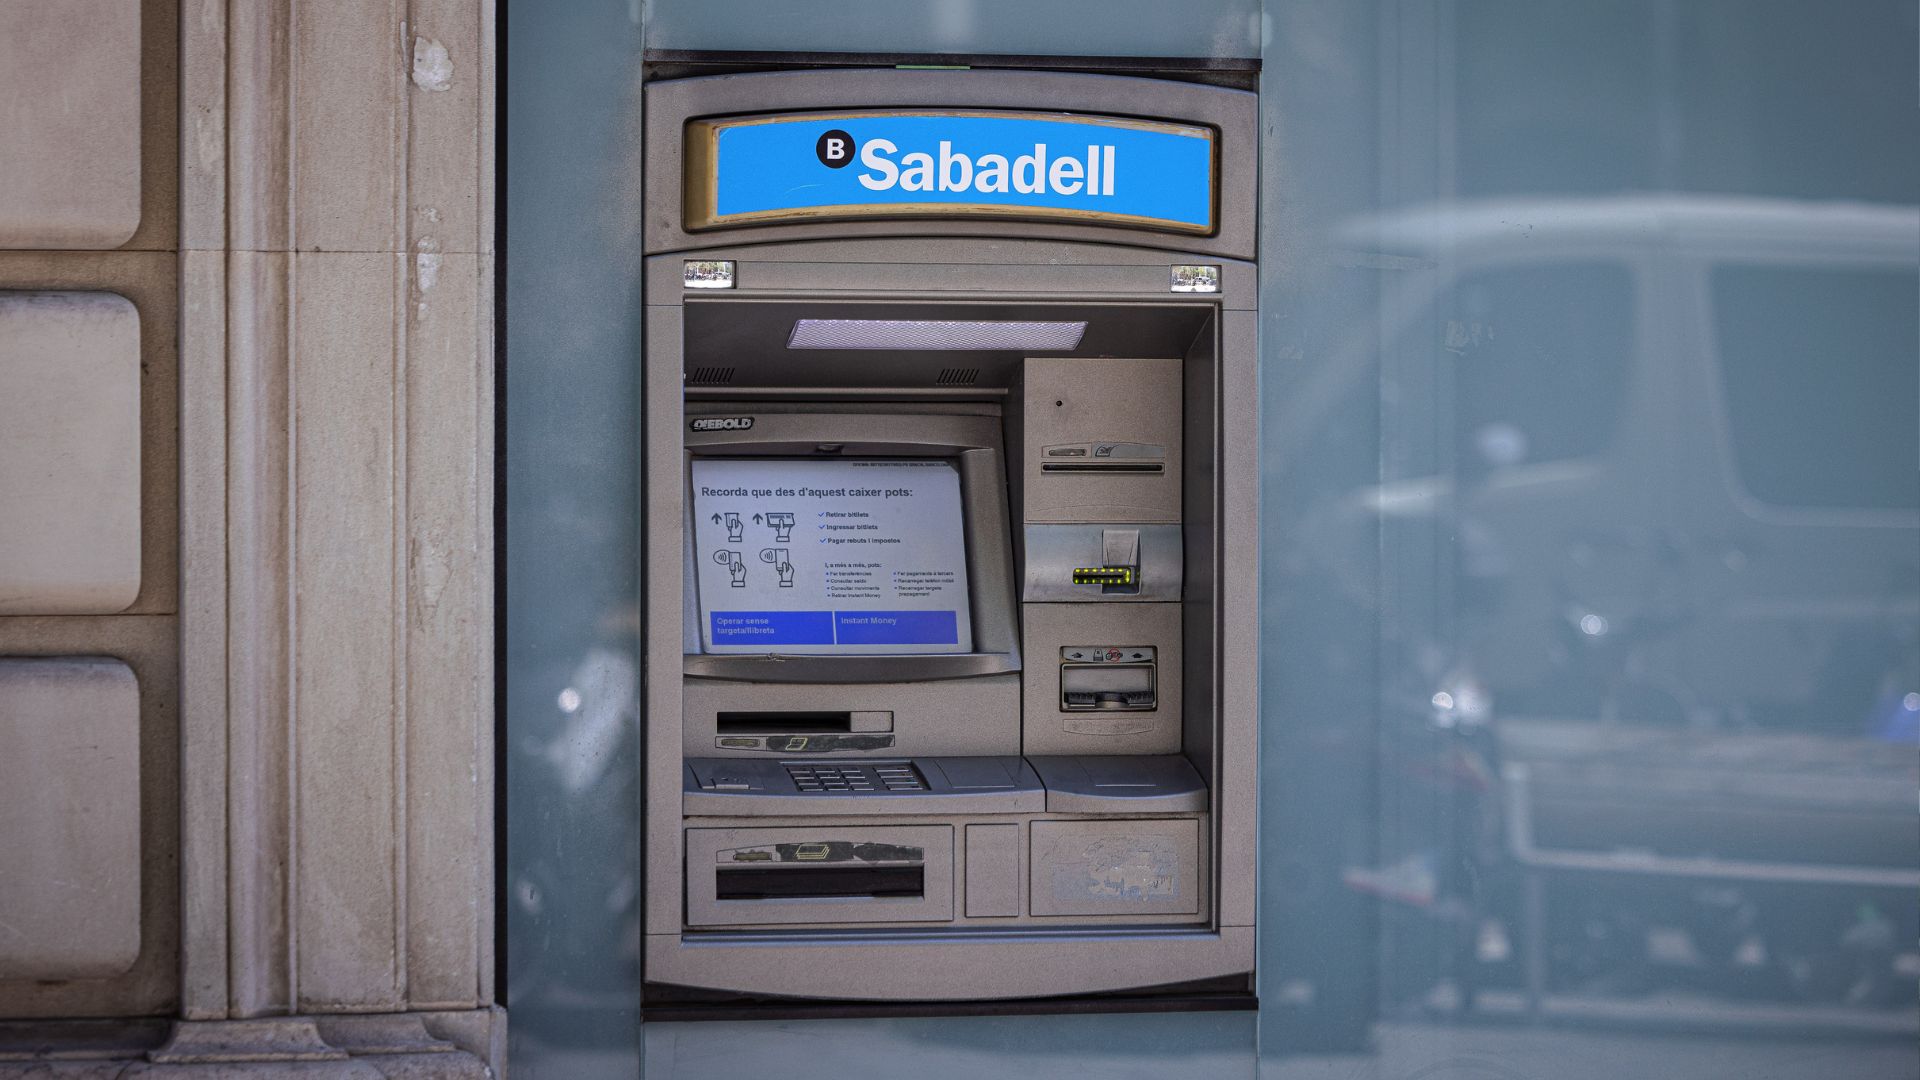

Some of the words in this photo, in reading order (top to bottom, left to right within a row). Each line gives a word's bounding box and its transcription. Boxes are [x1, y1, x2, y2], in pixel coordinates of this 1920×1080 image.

[826, 138, 845, 160] B
[857, 138, 1116, 196] Sabadell
[694, 418, 752, 430] DIEBOLD
[702, 487, 748, 496] Recorda
[751, 489, 772, 499] que
[775, 488, 796, 496] des
[798, 488, 846, 499] d'aquest
[848, 488, 882, 497] caixer
[885, 488, 913, 499] pots:
[717, 617, 743, 626] Operar
[870, 617, 897, 626] Money
